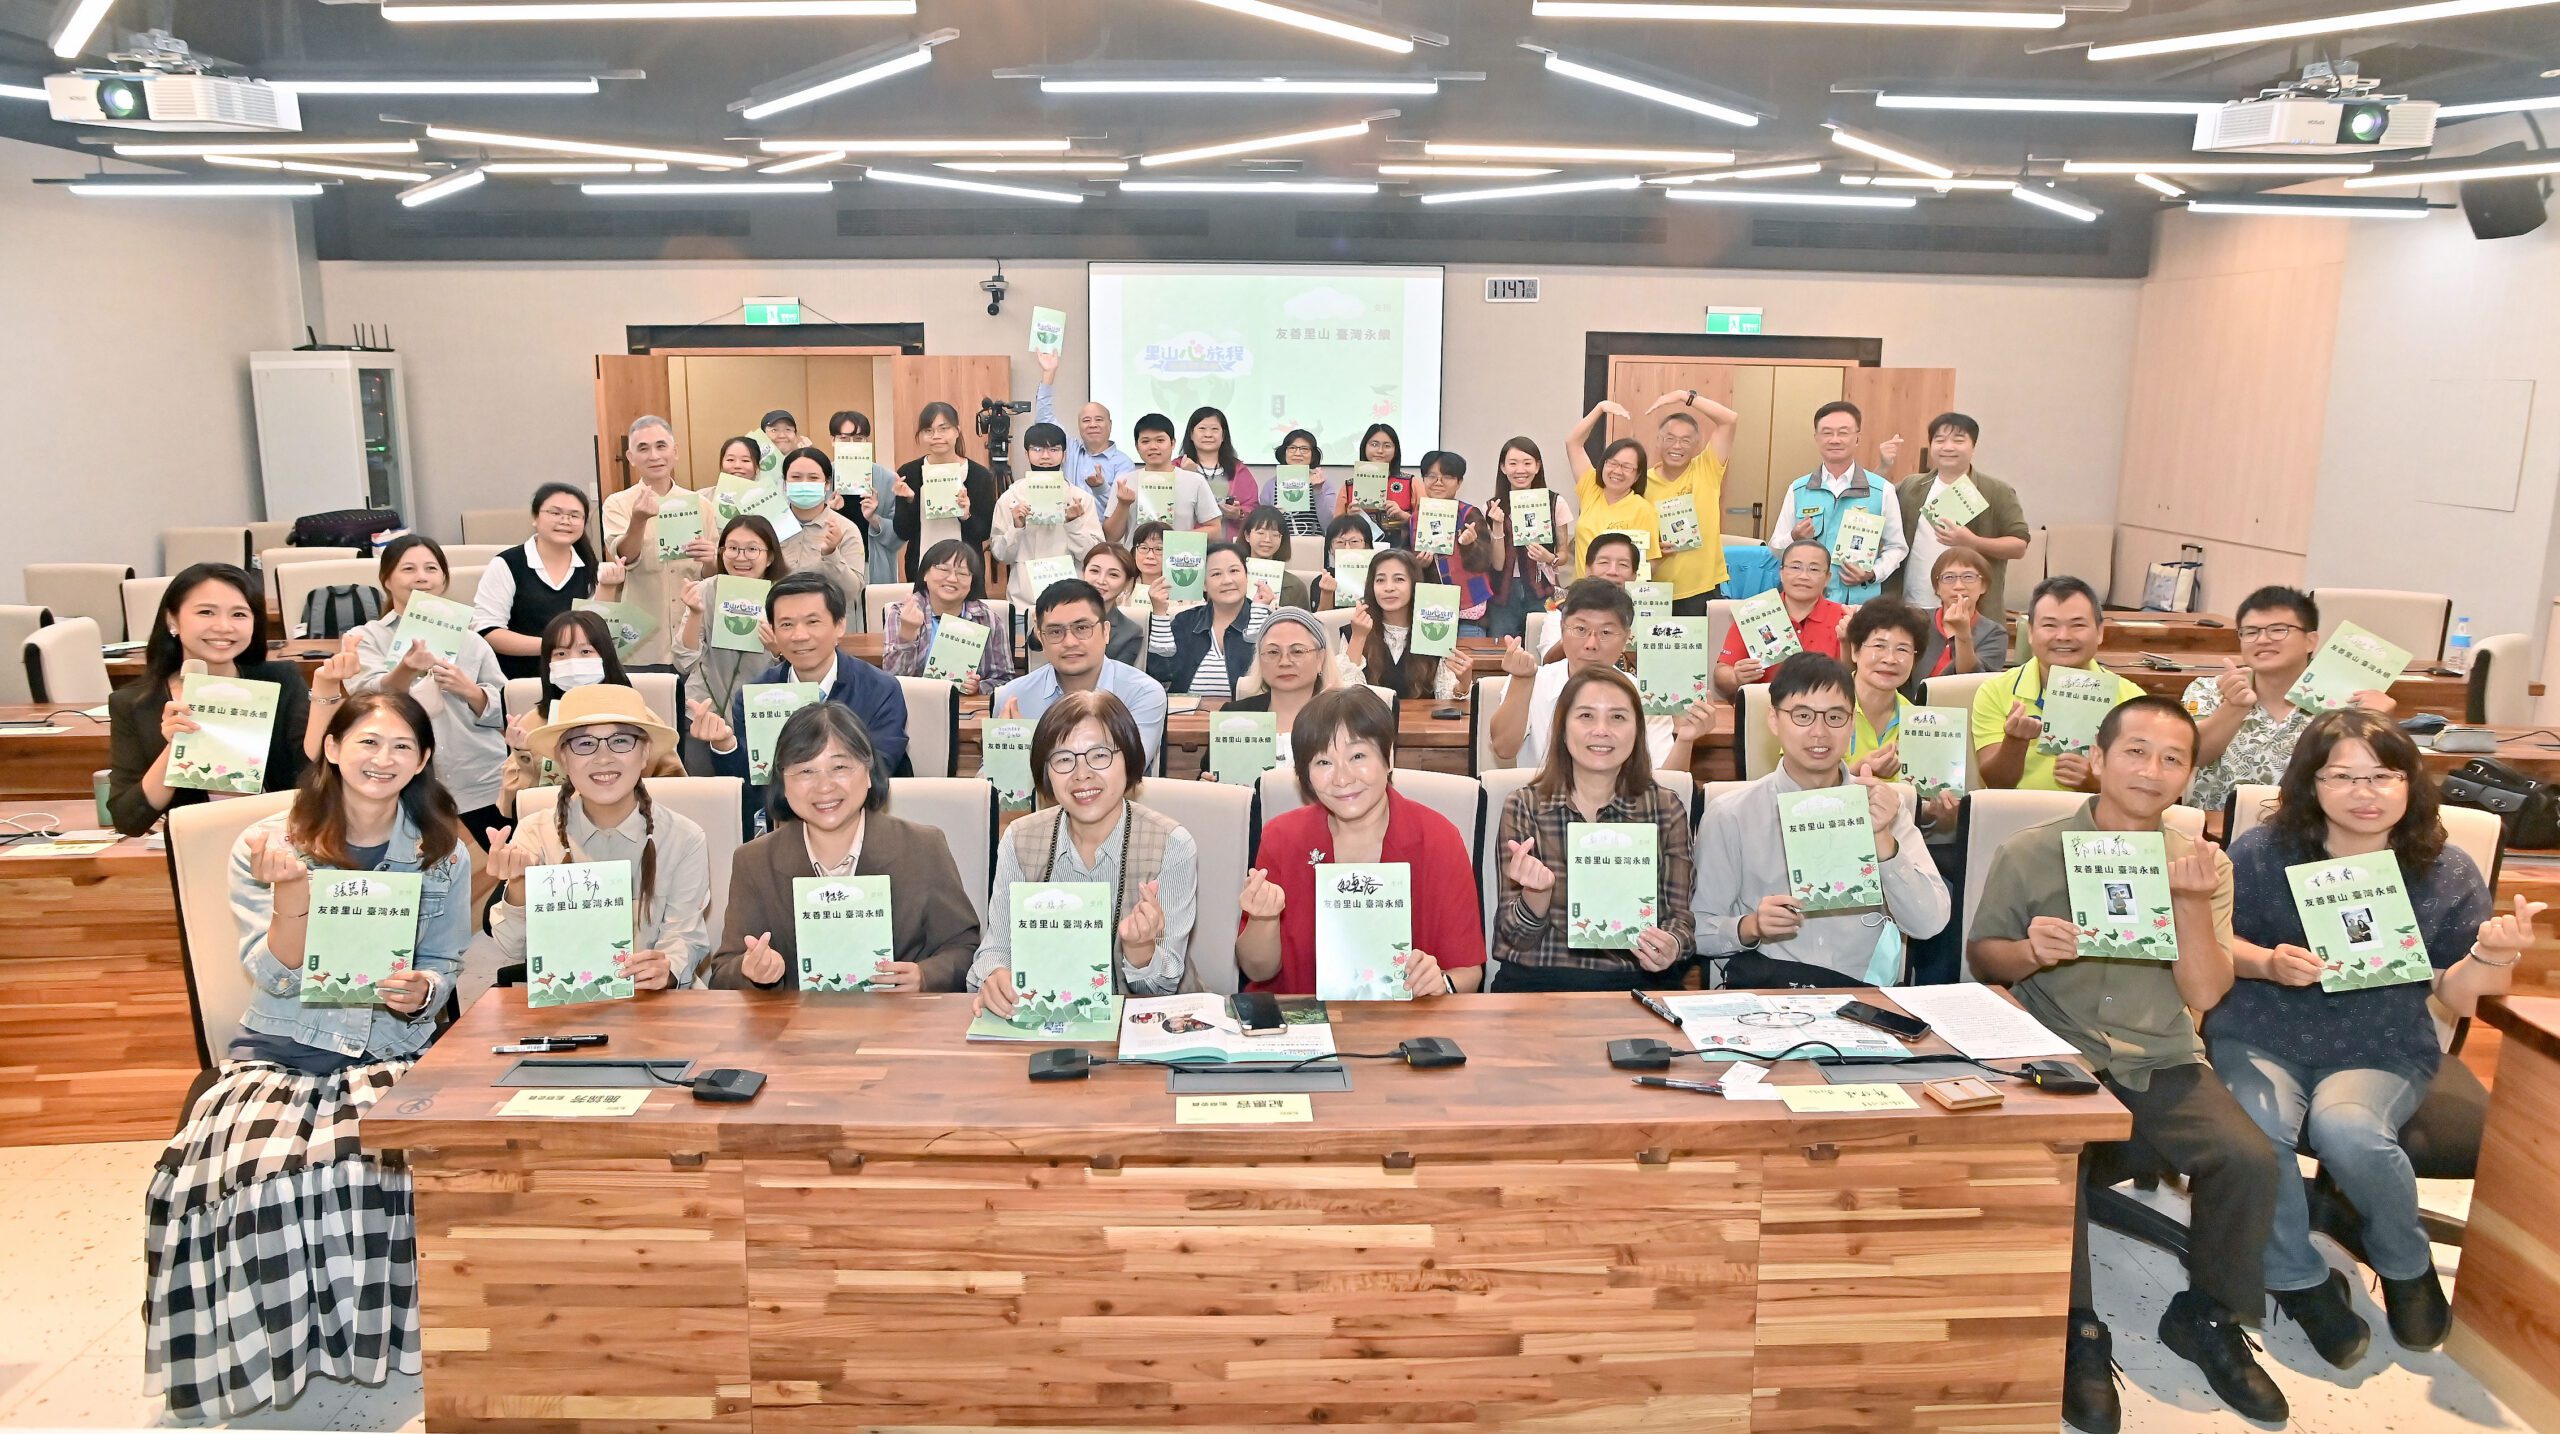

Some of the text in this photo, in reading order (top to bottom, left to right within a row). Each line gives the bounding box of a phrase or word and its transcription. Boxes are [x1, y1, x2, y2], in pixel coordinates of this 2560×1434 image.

[1276, 328, 1391, 340] 友善里山 臺灣永續
[1789, 821, 1825, 832] 友善里山
[1574, 856, 1611, 865] 友善里山
[2074, 865, 2113, 874] 友善里山
[2304, 893, 2348, 907] 友善里山
[318, 906, 362, 916] 友善里山
[535, 899, 578, 913] 友善里山
[802, 911, 841, 920] 友善里山
[1018, 919, 1103, 929] 友善里山 臺灣永續
